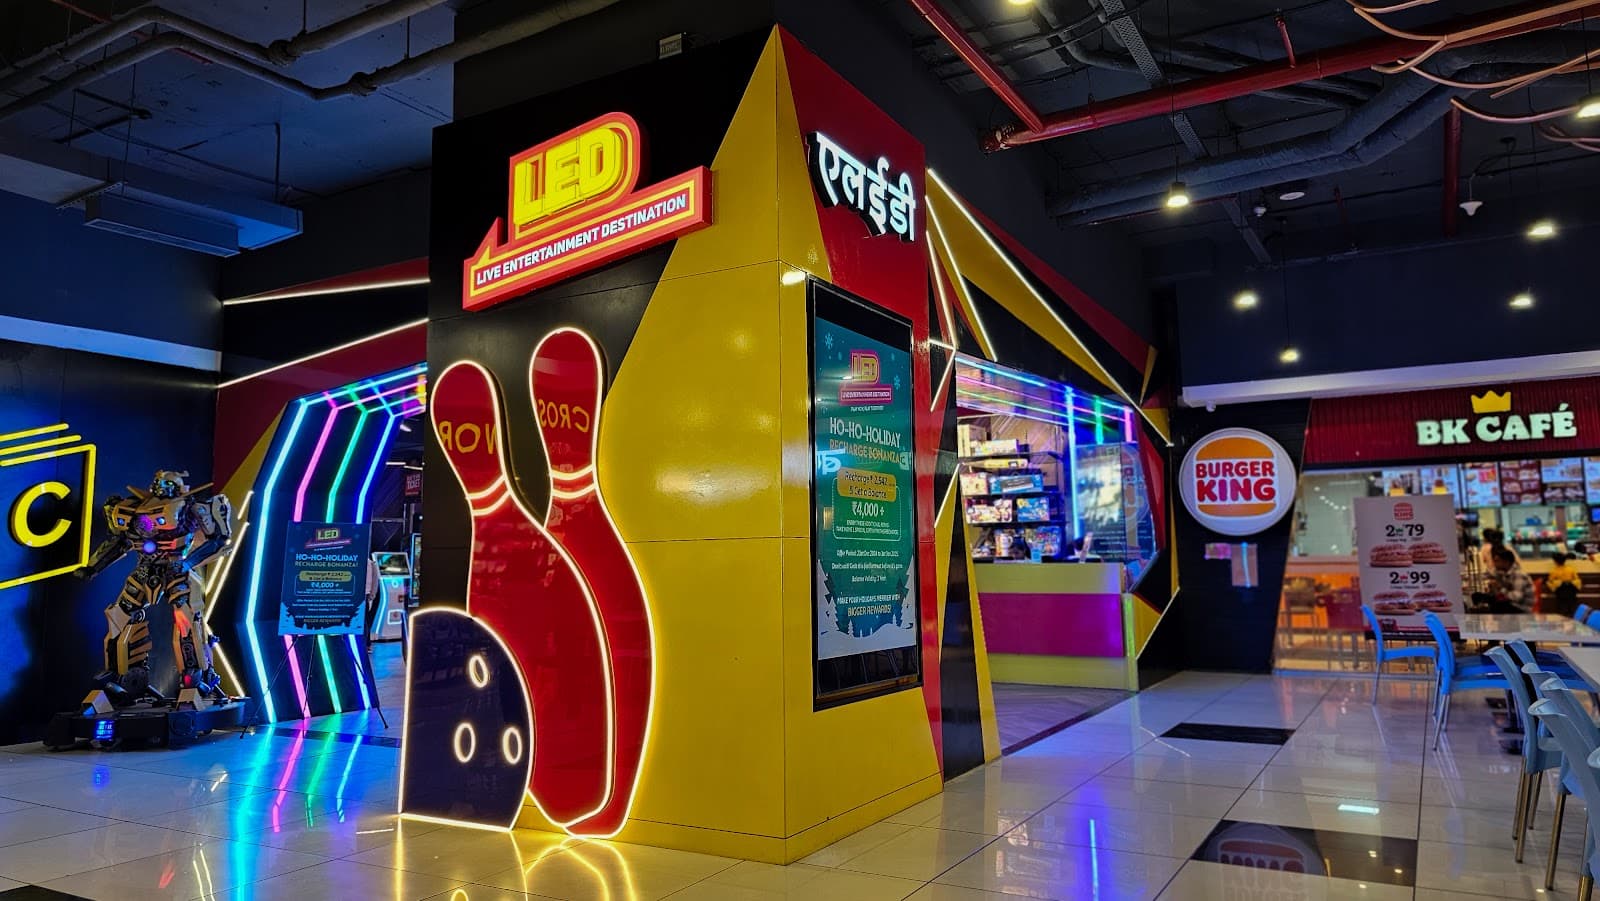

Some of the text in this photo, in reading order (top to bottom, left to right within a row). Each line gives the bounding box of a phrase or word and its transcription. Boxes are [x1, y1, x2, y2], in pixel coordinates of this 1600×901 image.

[513, 127, 624, 227] LED
[816, 131, 916, 242] एलईडी
[476, 194, 687, 286] LIVE ENTERTAINMENT DESTINATION
[853, 356, 878, 382] LED
[830, 416, 901, 448] HO-HO-HOLIDAY
[1416, 403, 1577, 446] BK CAFÉ
[1195, 461, 1275, 479] BURGER
[1196, 478, 1276, 502] KING
[14, 481, 72, 547] C
[317, 529, 340, 540] LED
[1385, 524, 1395, 537] 2
[295, 553, 359, 562] HO-HO-HOLIDAY
[1389, 571, 1399, 584] 2
